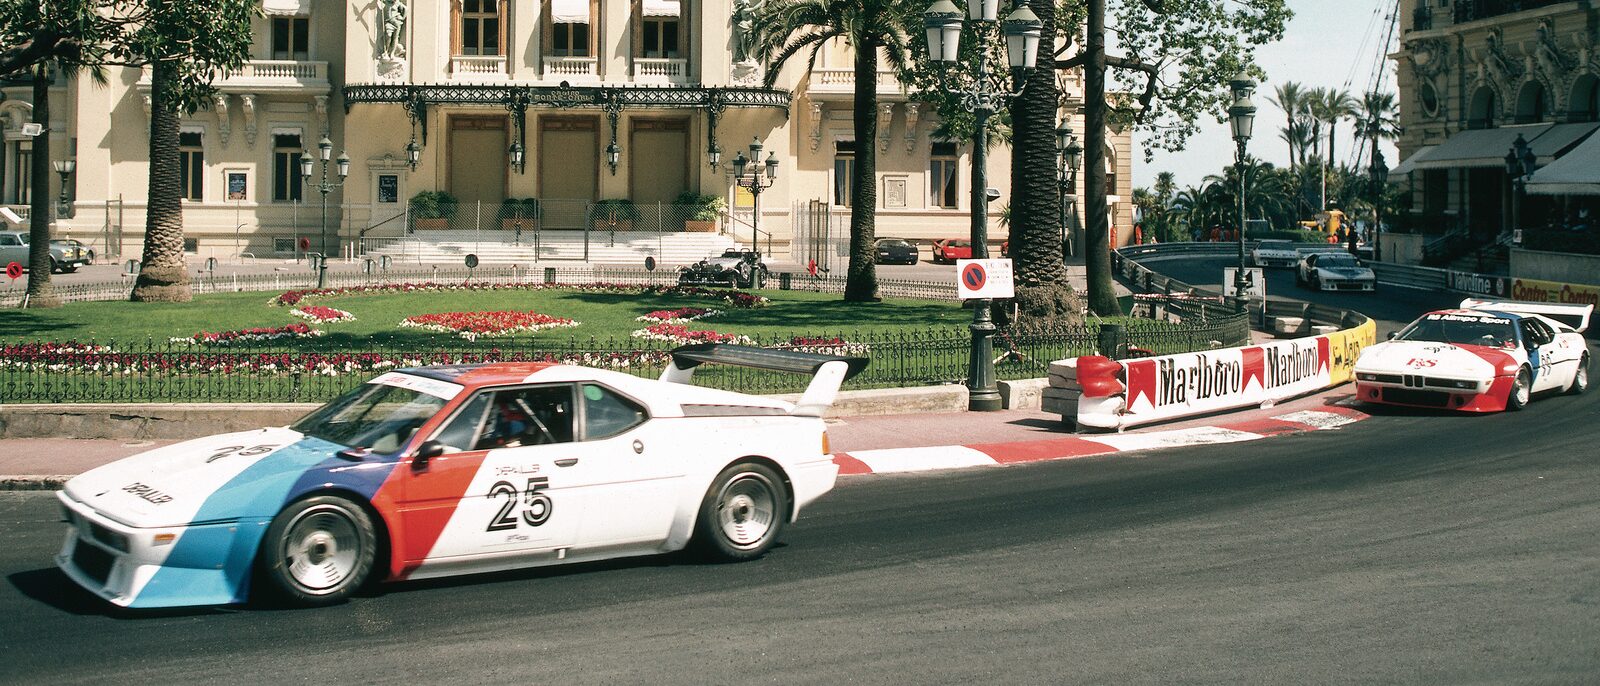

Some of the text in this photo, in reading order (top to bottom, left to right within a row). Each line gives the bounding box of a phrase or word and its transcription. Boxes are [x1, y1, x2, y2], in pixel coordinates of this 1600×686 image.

[1454, 271, 1491, 294] Valvoline
[1512, 279, 1548, 301] Contro
[1441, 314, 1478, 322] Alimpo
[1479, 316, 1511, 325] Sport
[1159, 342, 1318, 407] Marlboro Marlboro
[206, 443, 281, 464] 25
[486, 476, 553, 532] 25
